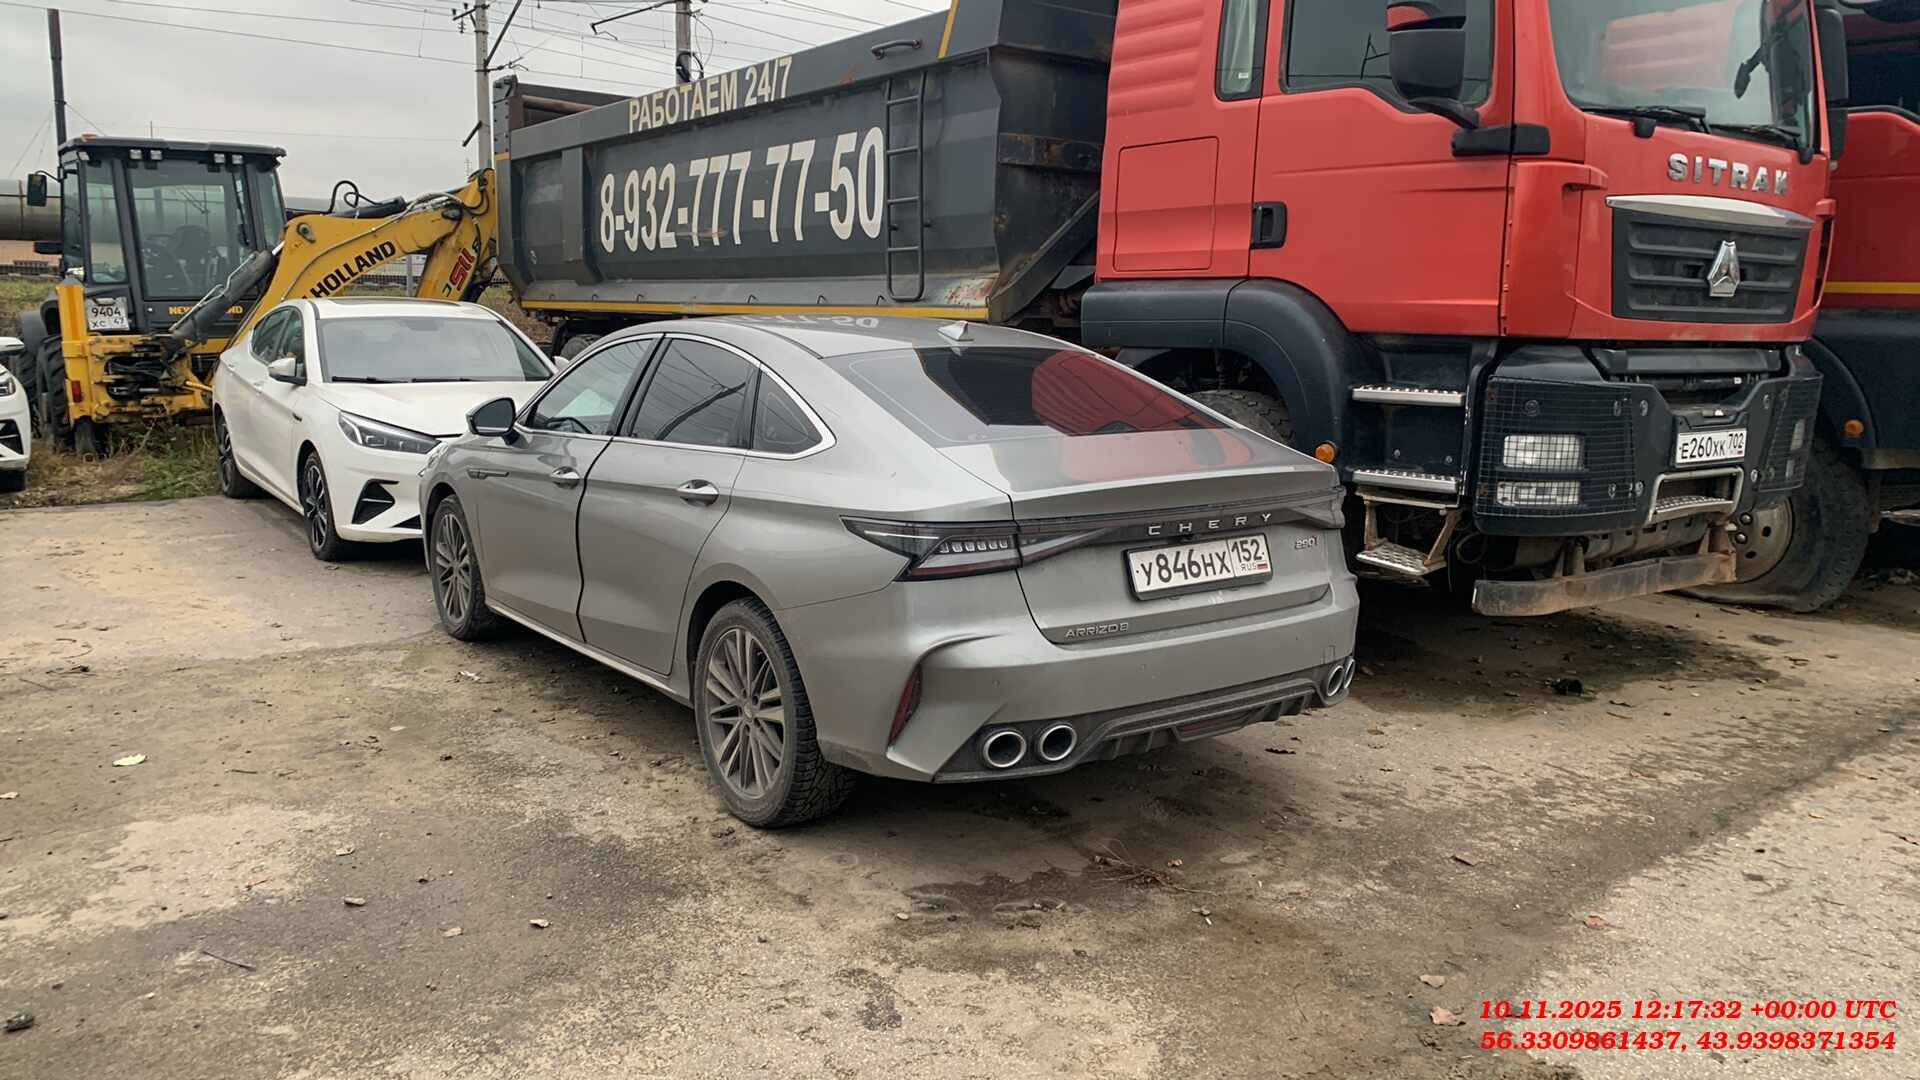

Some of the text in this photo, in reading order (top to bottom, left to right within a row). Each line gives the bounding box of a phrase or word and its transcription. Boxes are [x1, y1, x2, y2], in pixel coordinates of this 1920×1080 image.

[629, 56, 793, 133] РАБОТАЕМ 24/7
[601, 127, 884, 252] 8-932-777-77-50
[1667, 152, 1788, 195] SITRAK
[310, 240, 397, 299] HOLLAND
[91, 306, 121, 318] 9404
[1148, 513, 1272, 536] CHERY
